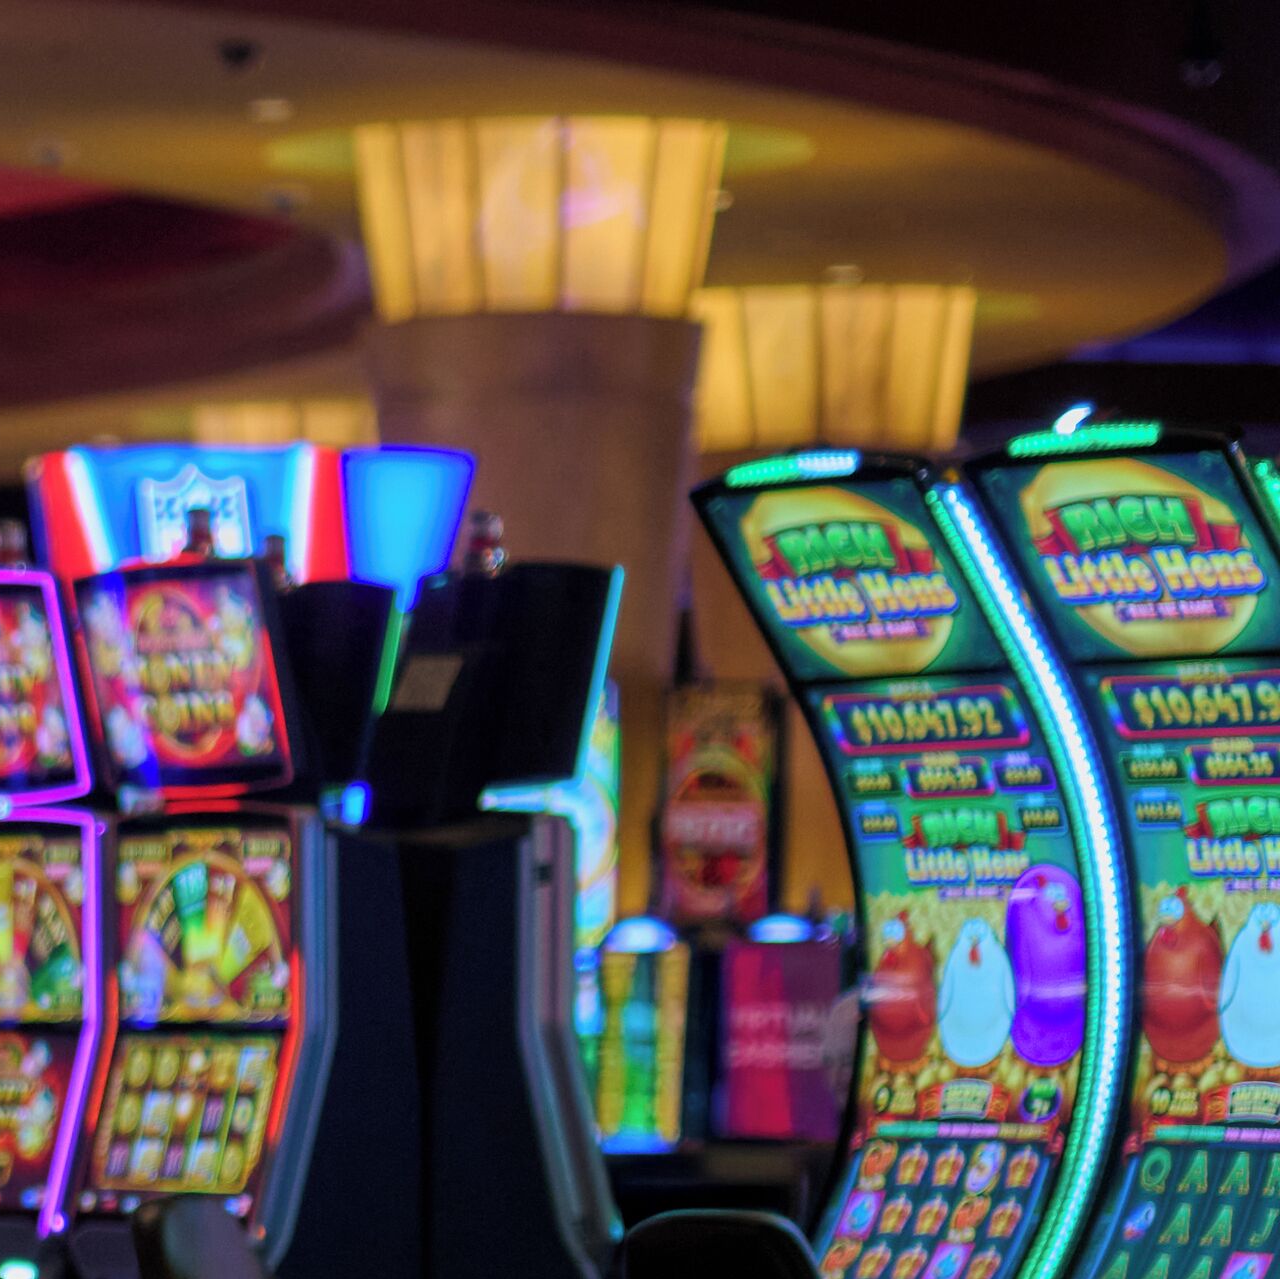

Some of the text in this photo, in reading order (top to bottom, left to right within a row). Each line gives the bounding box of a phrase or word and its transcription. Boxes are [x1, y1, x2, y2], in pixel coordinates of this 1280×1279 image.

[775, 520, 897, 575] RICH
[1060, 496, 1197, 552] RICH
[764, 571, 957, 625] Little Hens
[1042, 545, 1266, 604] Little Hens
[921, 807, 999, 848] RICH
[905, 846, 970, 884] Little
